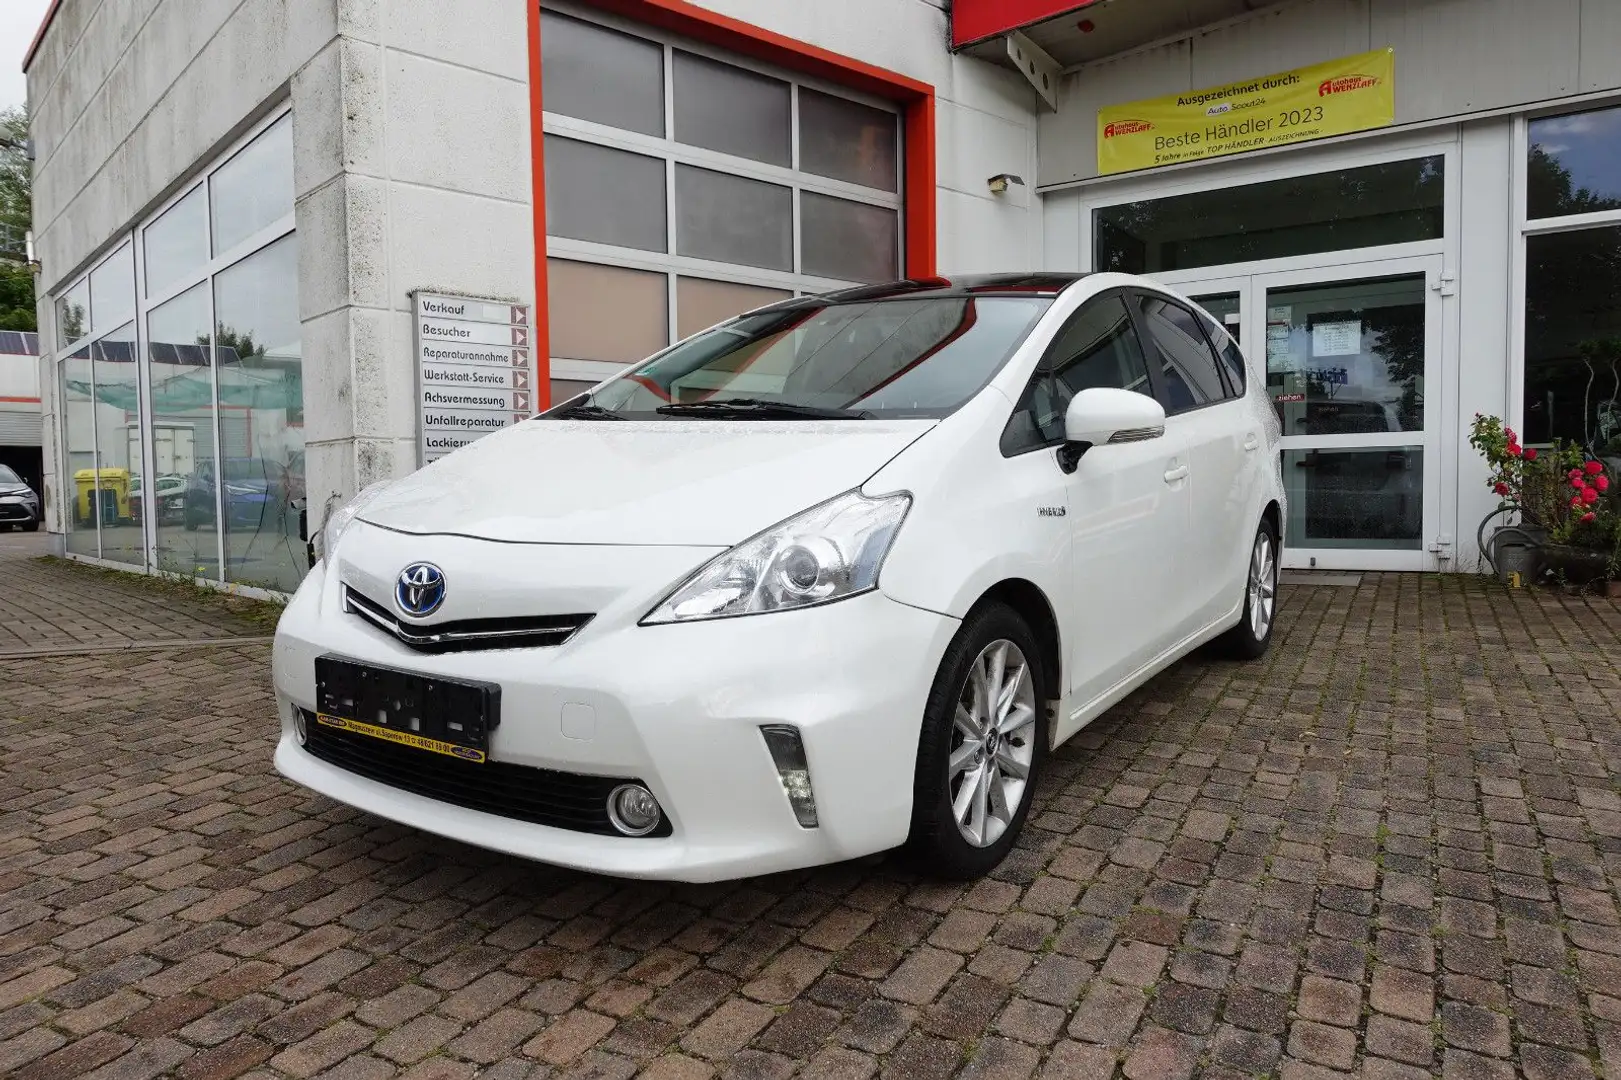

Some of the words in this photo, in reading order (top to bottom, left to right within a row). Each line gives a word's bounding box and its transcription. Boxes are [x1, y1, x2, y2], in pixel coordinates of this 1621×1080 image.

[1177, 83, 1260, 106] Ausgezeichnet
[1263, 74, 1300, 89] durch:
[1154, 132, 1201, 151] Beste
[1205, 117, 1273, 141] Händler
[1279, 105, 1324, 128] 2023
[1207, 144, 1224, 154] TOP
[1224, 137, 1265, 150] HÄNDLER
[423, 301, 465, 315] Verkauf
[423, 324, 471, 338] Besucher
[423, 347, 509, 363] Reparaturannahme
[424, 369, 505, 384] Werkstatt-Service
[424, 392, 505, 408] Achsvermessung
[1278, 393, 1301, 402] ziehen
[425, 414, 505, 429] Unfallreparatur
